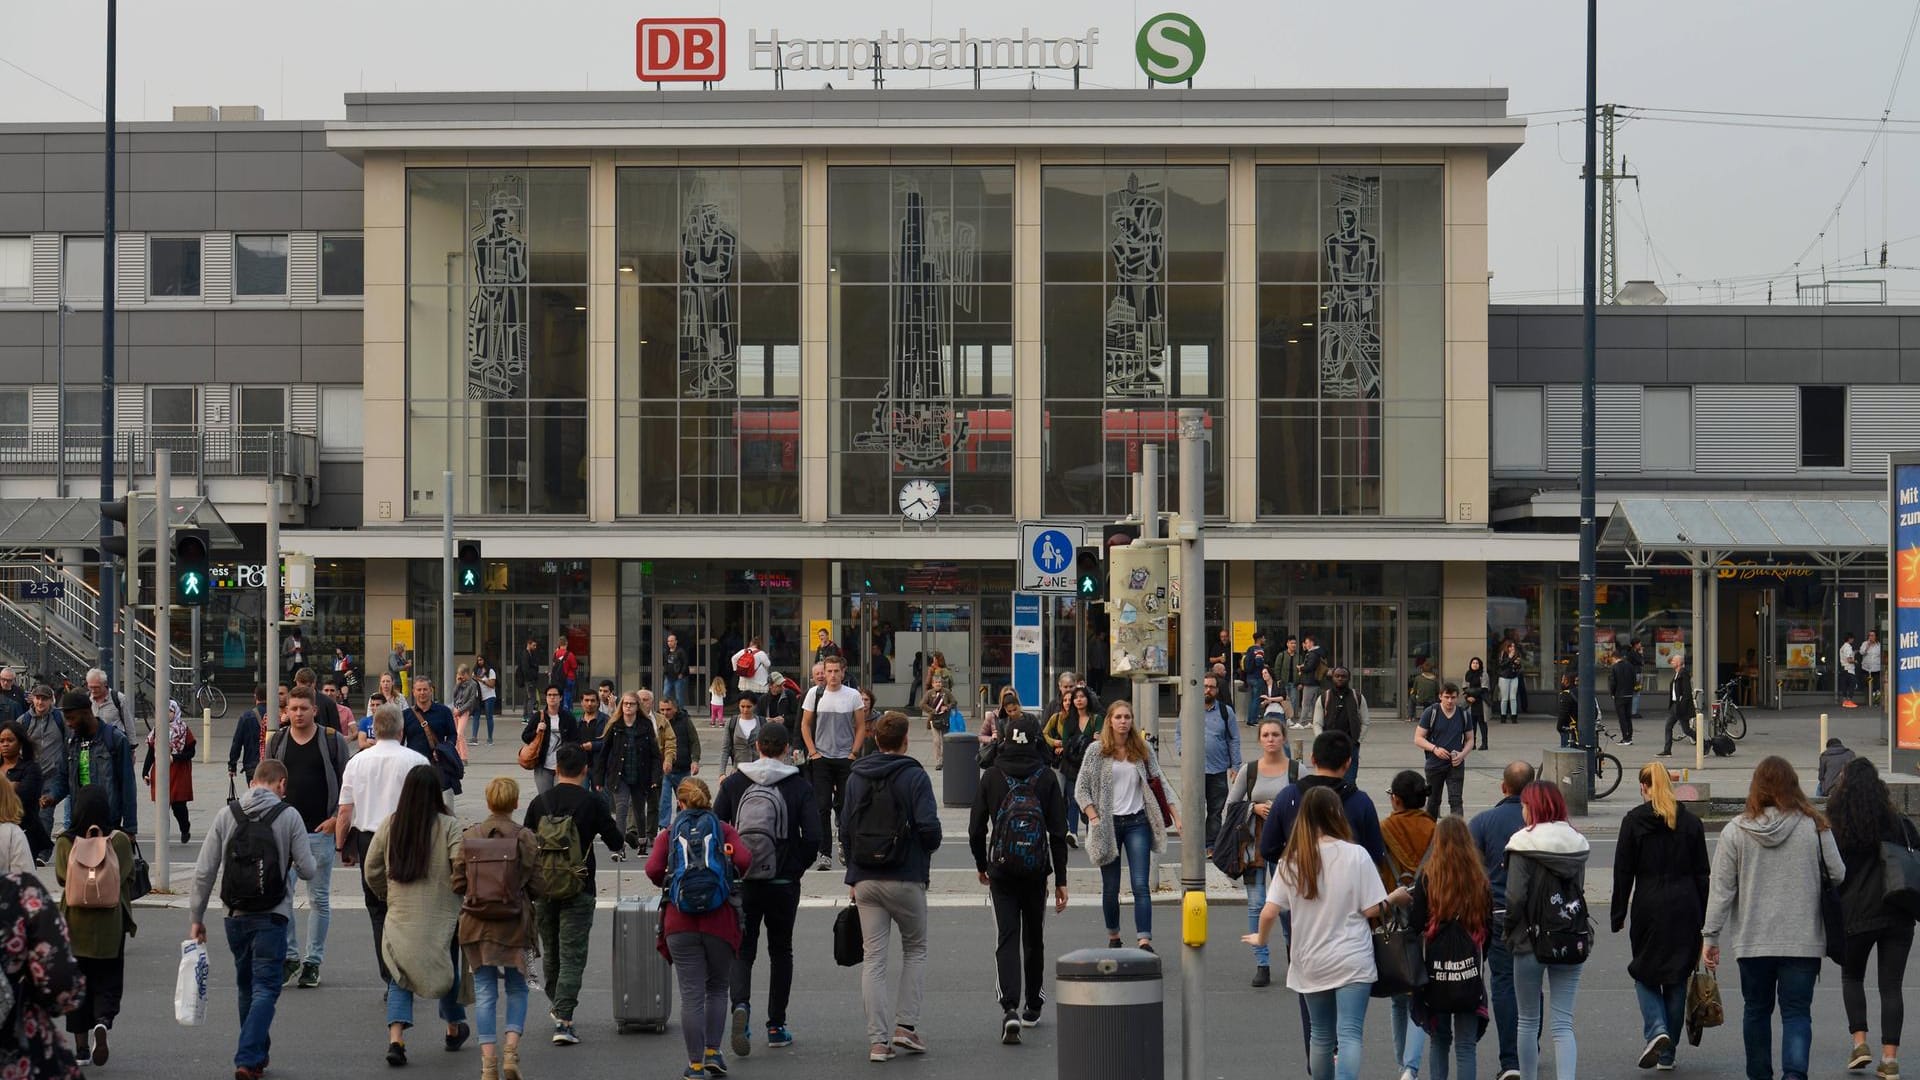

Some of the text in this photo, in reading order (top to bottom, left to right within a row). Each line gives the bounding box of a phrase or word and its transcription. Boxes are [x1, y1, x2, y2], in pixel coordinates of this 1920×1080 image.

[648, 28, 715, 71] DB
[748, 27, 1100, 81] Hauptbahnhof
[1146, 19, 1194, 77] S
[1899, 487, 1919, 506] Mit
[208, 567, 229, 576] ress
[30, 583, 49, 594] 2-5
[1037, 575, 1068, 588] ZONE
[1899, 631, 1919, 649] Mit
[1011, 728, 1029, 744] LA
